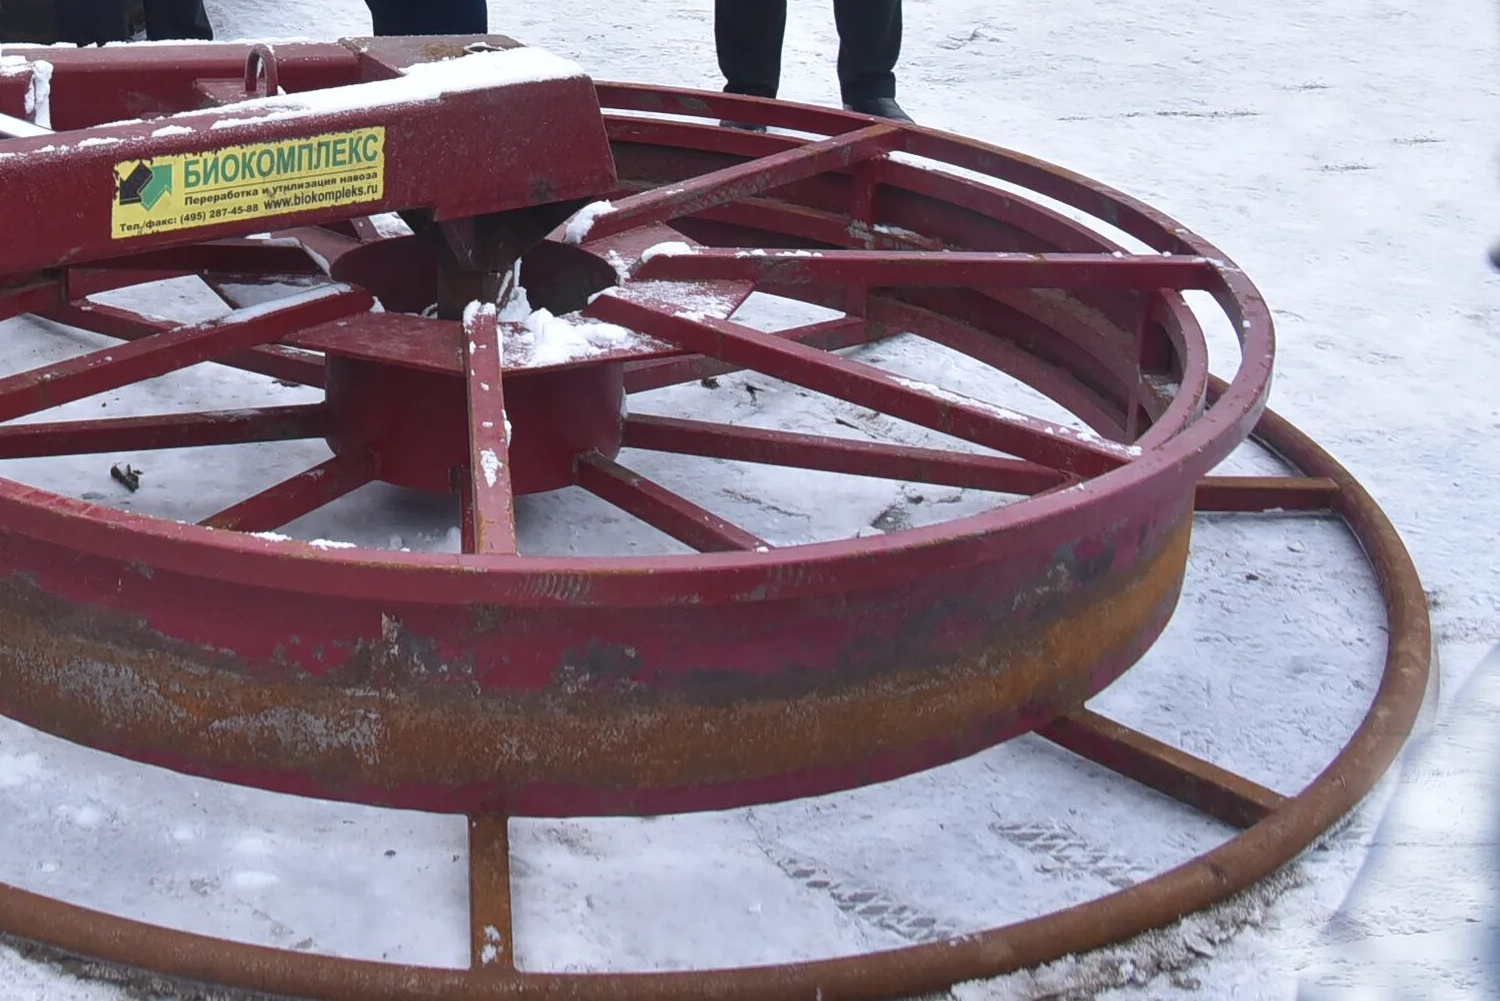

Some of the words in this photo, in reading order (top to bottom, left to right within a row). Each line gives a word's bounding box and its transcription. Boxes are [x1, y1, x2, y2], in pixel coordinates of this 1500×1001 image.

[183, 134, 379, 188] БИОКОМПЛЕКС
[183, 188, 259, 206] Переработка
[262, 187, 270, 195] и
[271, 179, 337, 197] утилизация
[340, 171, 378, 184] навоза
[263, 183, 378, 210] www.biokompleks.ru
[119, 217, 177, 232] Тел./факс:
[180, 211, 206, 225] (495)
[209, 203, 259, 219] 287-45-88
